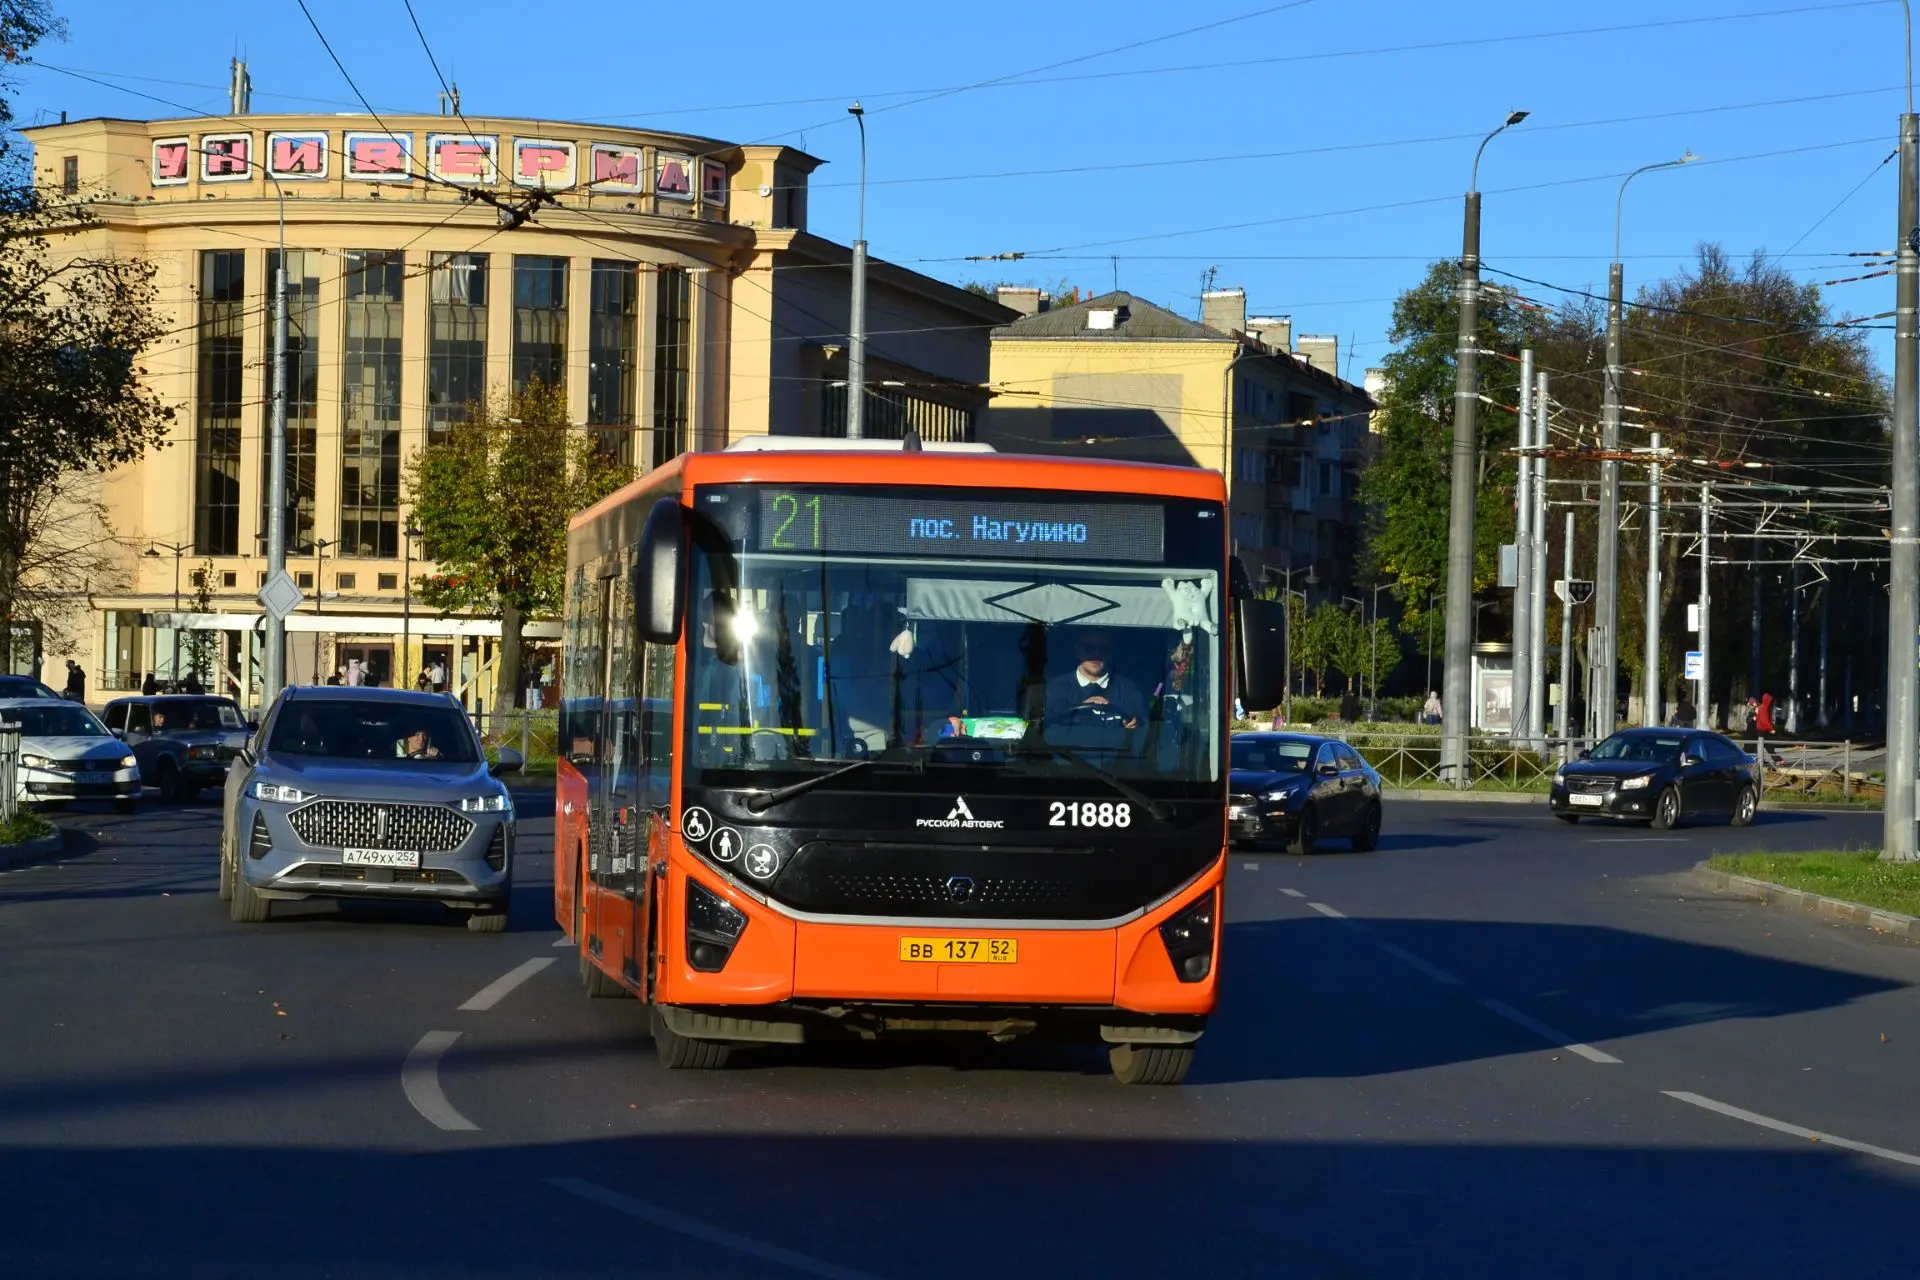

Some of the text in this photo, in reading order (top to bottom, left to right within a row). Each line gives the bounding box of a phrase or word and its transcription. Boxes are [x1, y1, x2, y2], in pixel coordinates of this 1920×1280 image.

[157, 140, 724, 193] УНИВЕРМАГ
[771, 494, 822, 550] 21
[910, 515, 1088, 544] пос. Нагулино
[916, 818, 1004, 829] РУССКИЙ АВТОБУС
[1049, 802, 1131, 828] 21888
[397, 851, 416, 862] 252
[944, 940, 979, 959] 137
[991, 940, 1009, 955] 52
